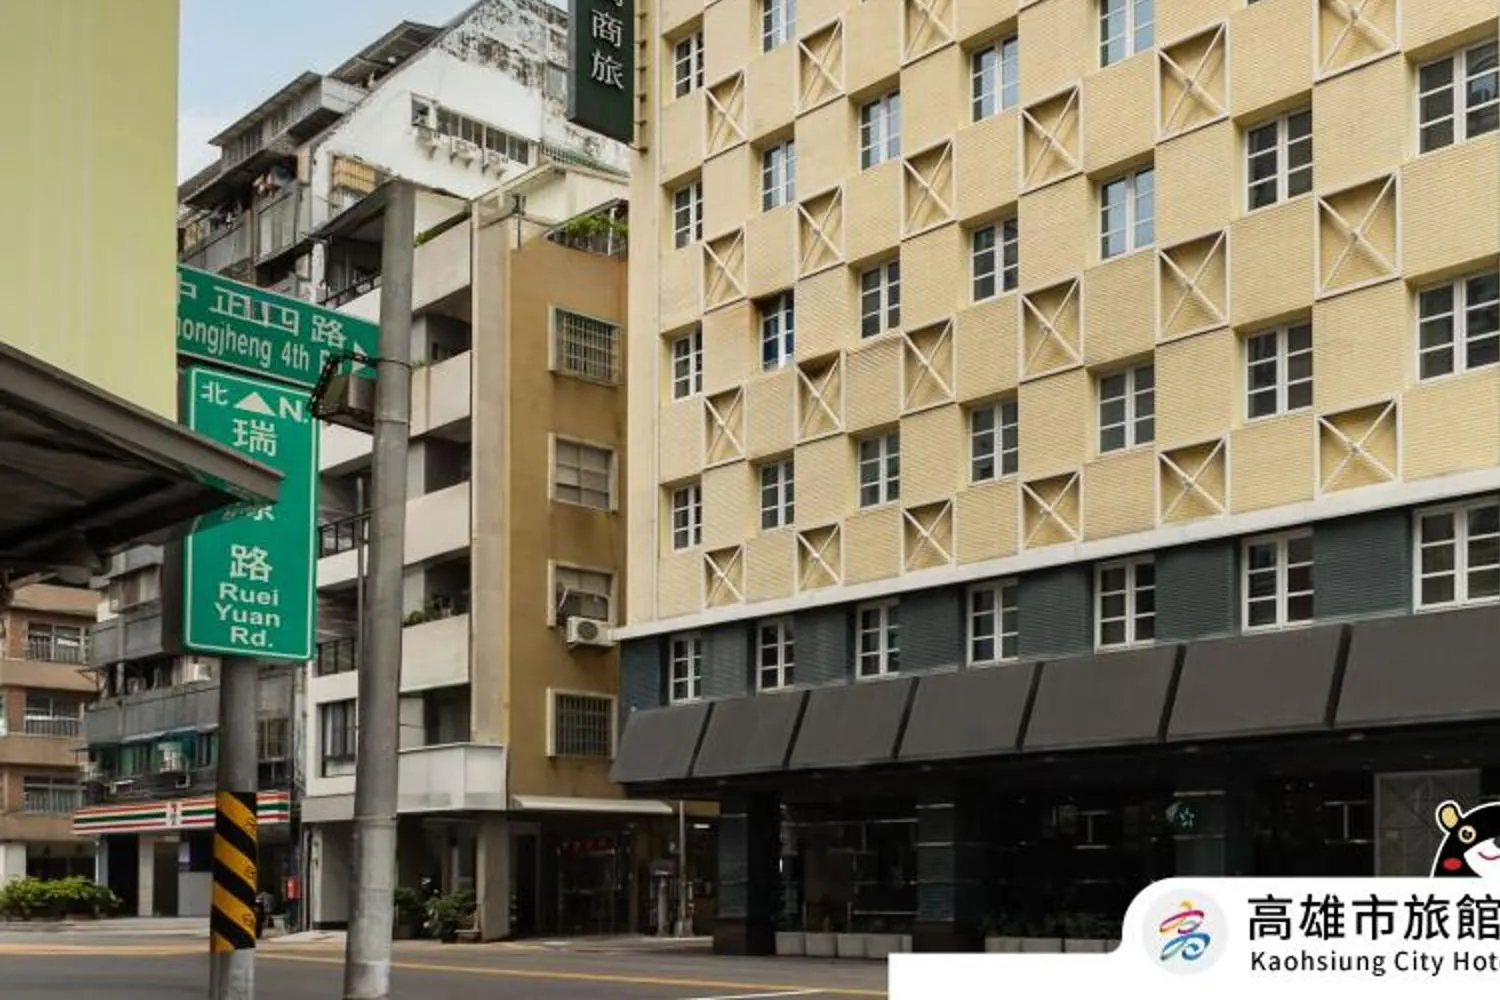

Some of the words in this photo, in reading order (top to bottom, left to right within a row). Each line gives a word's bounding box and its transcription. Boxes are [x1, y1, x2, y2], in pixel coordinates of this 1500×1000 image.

[176, 316, 272, 368] ongjheng
[281, 341, 310, 372] 4th
[201, 380, 228, 405] 北
[219, 582, 280, 607] Ruei
[214, 602, 281, 629] Yuan
[230, 626, 274, 648] Rd.
